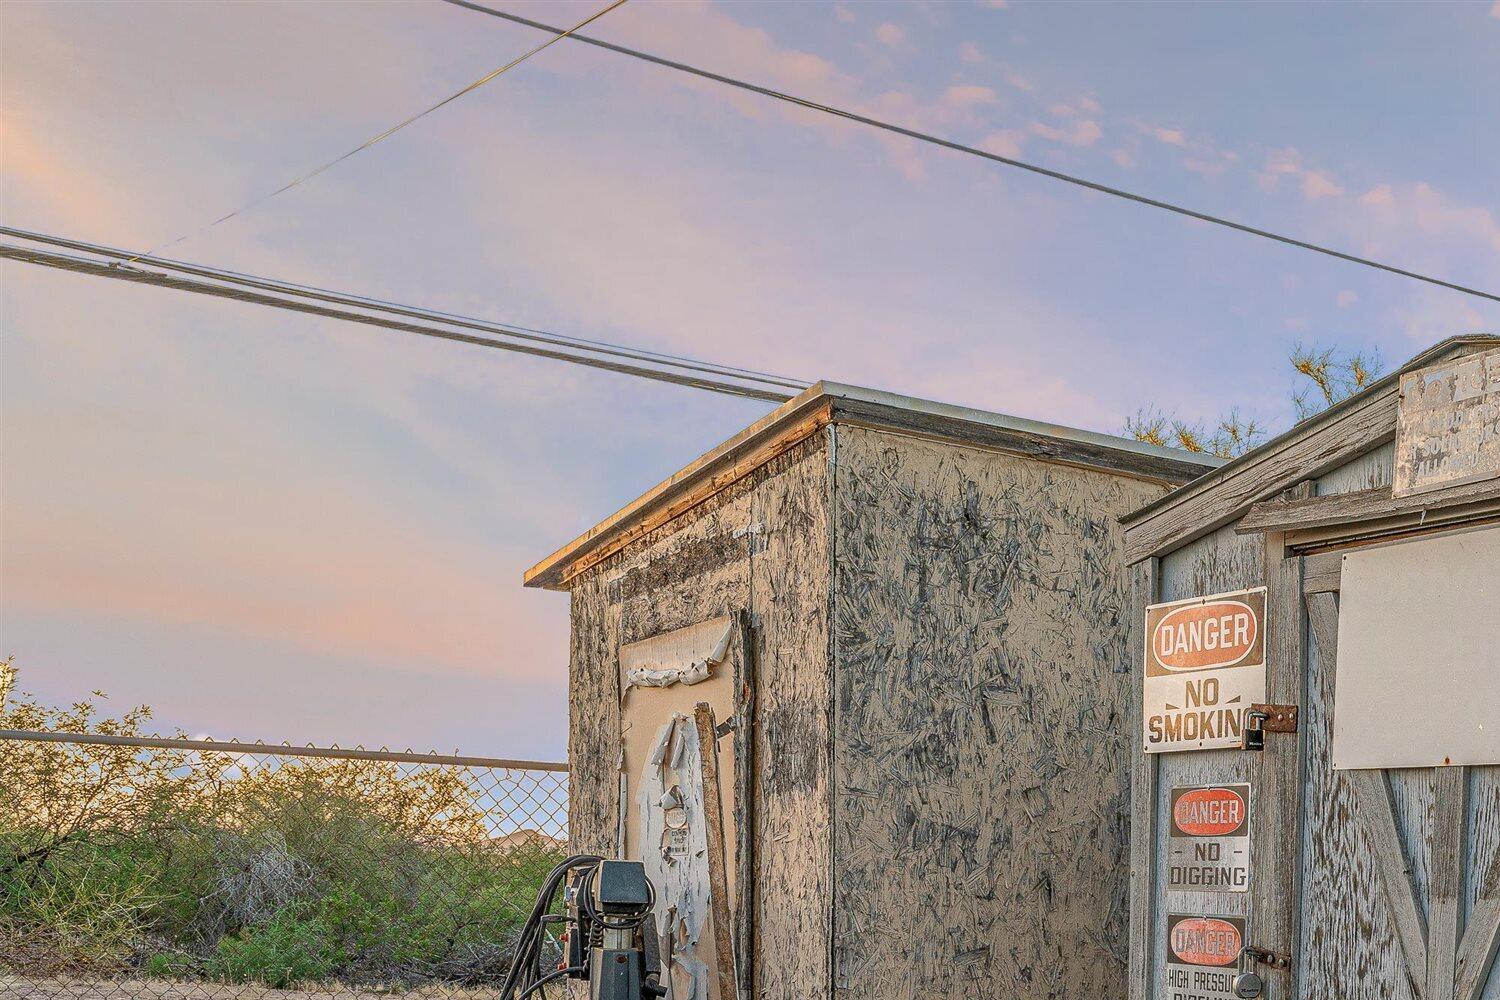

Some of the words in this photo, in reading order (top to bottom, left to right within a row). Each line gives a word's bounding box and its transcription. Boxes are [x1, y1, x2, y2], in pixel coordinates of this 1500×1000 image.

[1161, 613, 1249, 656] DANGER
[1186, 678, 1219, 708] NO
[1149, 707, 1249, 743] SMOKIN
[1180, 799, 1239, 824] DANGER
[1195, 843, 1220, 862] NO
[1170, 866, 1246, 886] DIGGING
[1175, 928, 1236, 957] DANGER
[1169, 969, 1189, 989] HIGH
